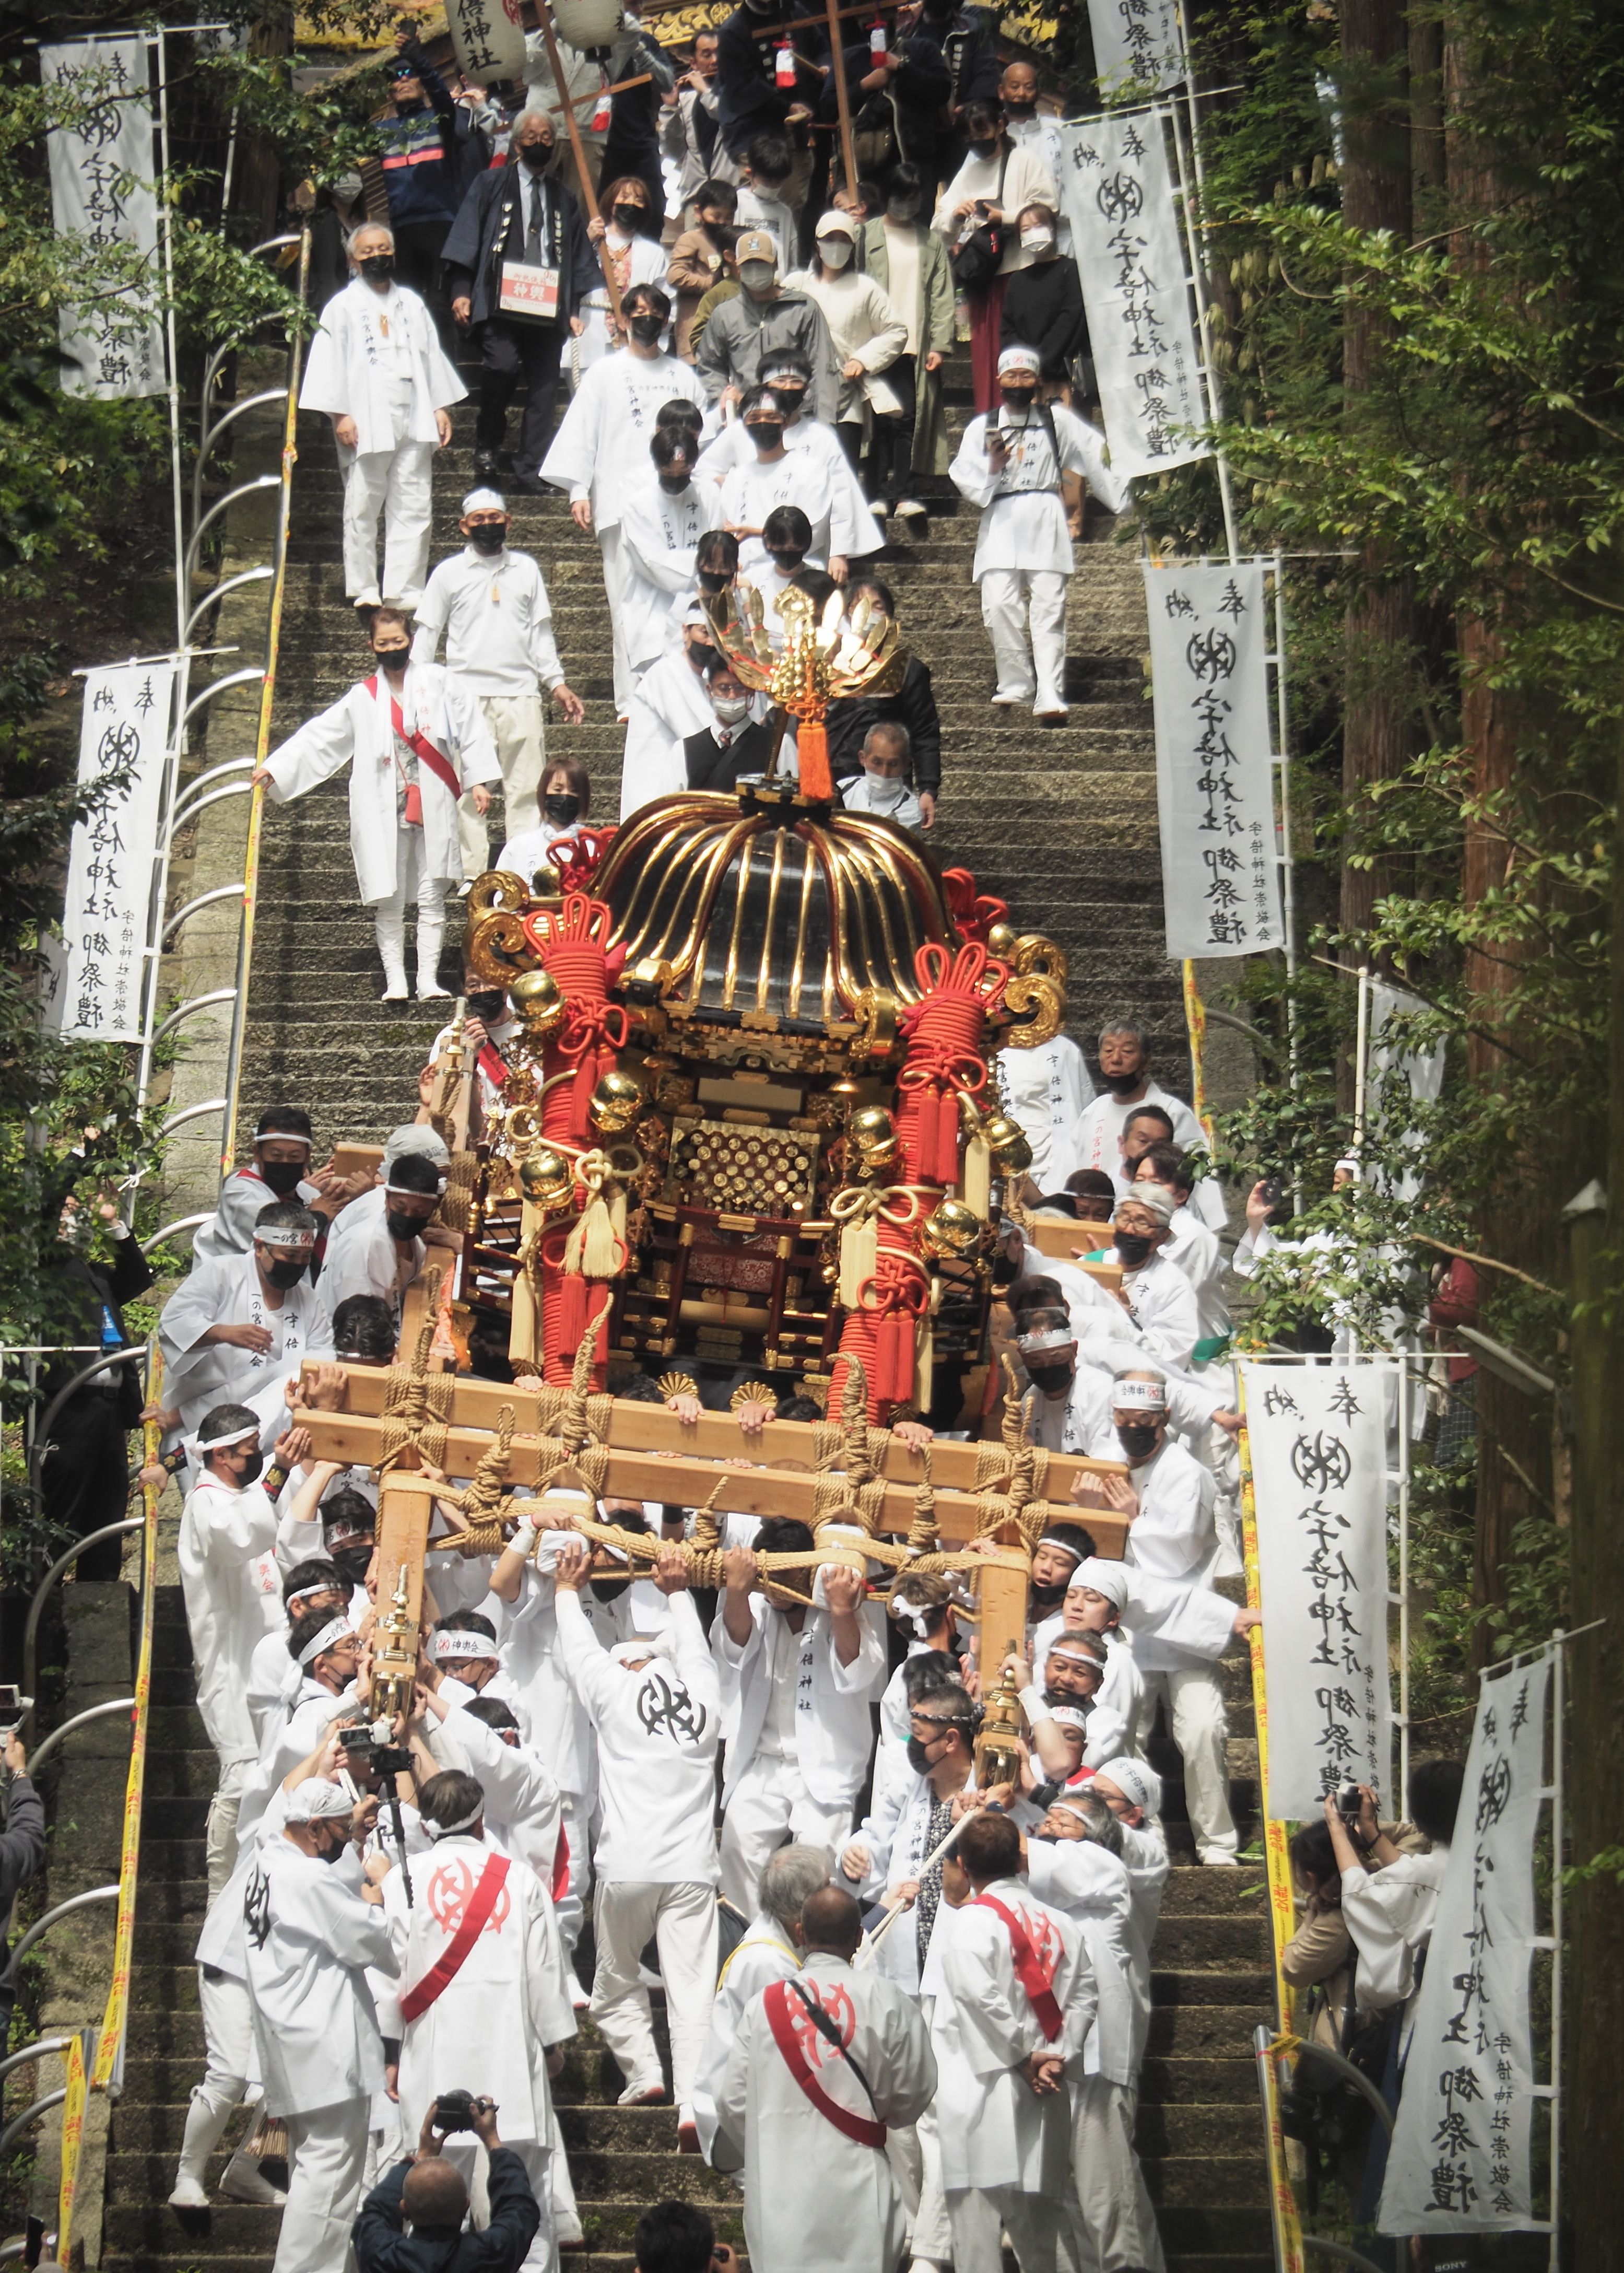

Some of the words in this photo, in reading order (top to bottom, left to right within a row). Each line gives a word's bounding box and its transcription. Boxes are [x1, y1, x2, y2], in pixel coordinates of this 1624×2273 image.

[1046, 1054, 1064, 1125] 宇倍神社
[272, 1233, 298, 1245] 一の宮
[250, 1294, 263, 1367] 一の宮会
[284, 1312, 299, 1350] 宇倍
[1063, 1403, 1076, 1440] 宇倍
[797, 1628, 815, 1710] 宇倍神社
[1273, 1884, 1289, 1913] 立入禁止
[1434, 2260, 1467, 2273] SONY
